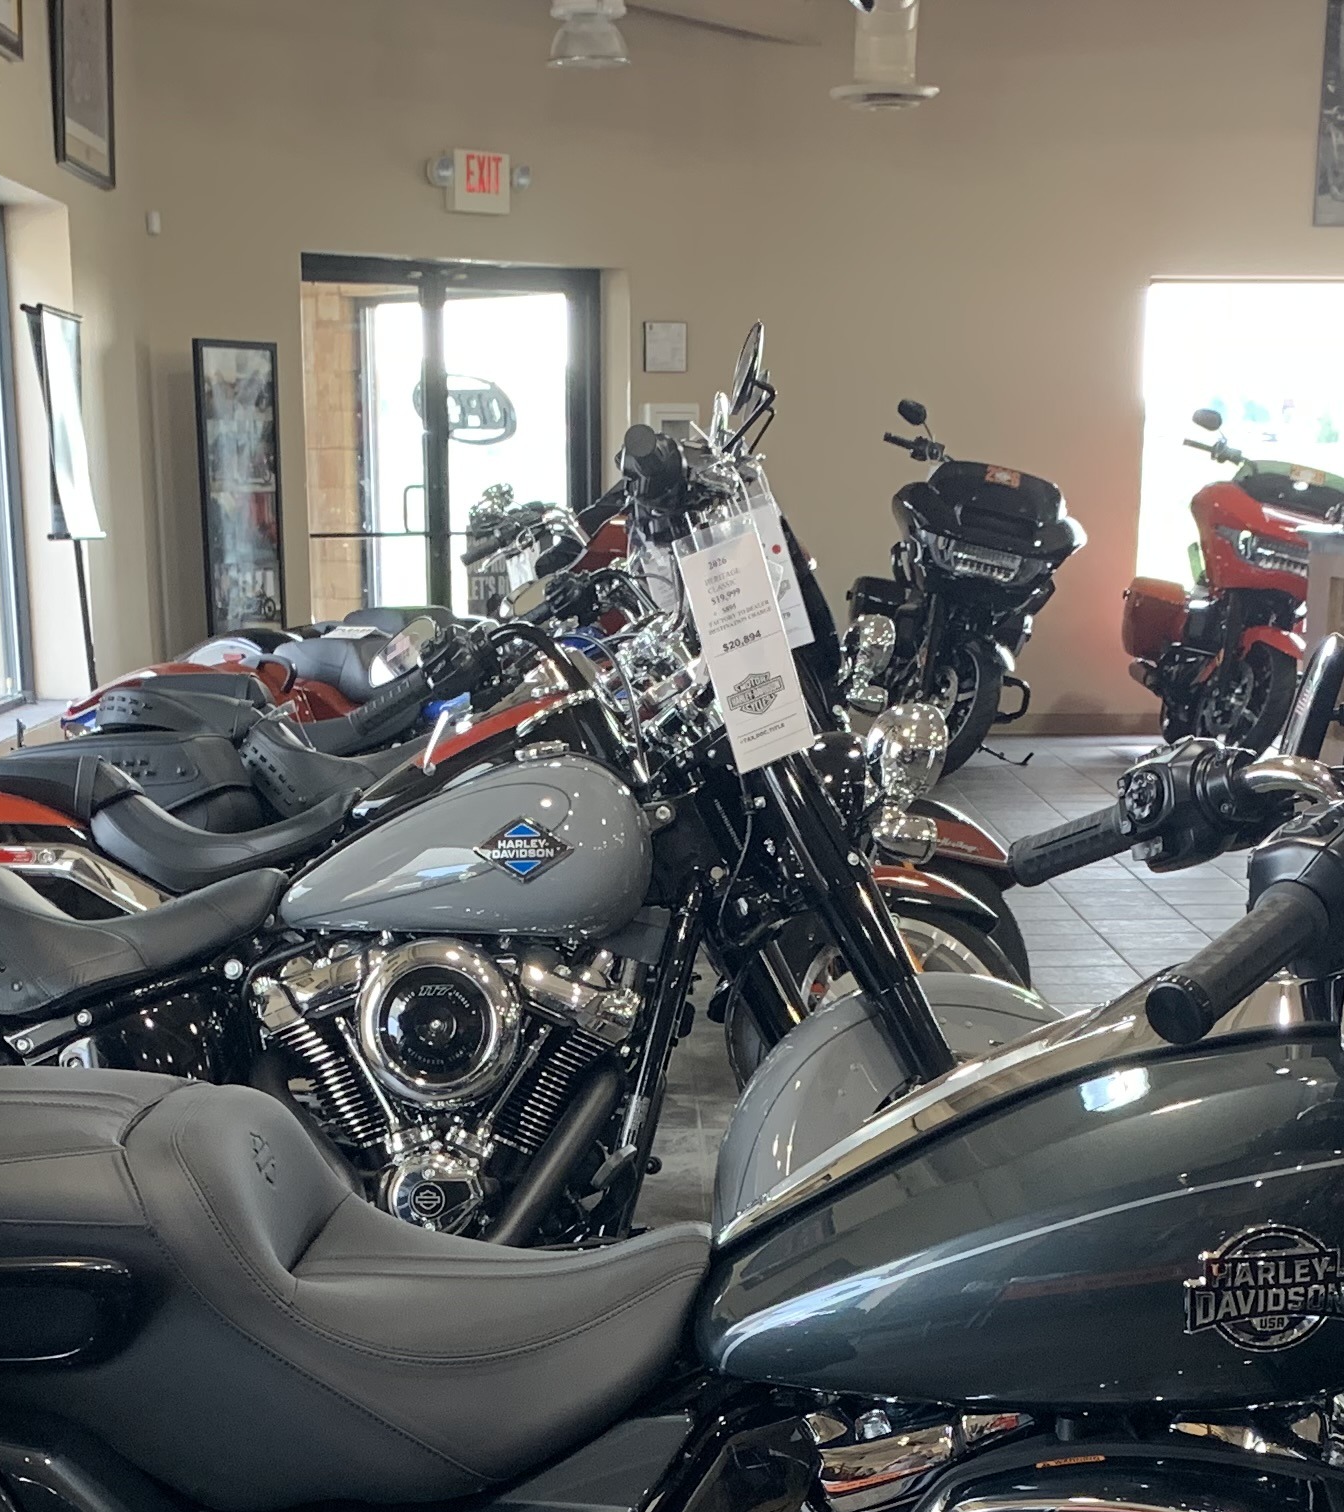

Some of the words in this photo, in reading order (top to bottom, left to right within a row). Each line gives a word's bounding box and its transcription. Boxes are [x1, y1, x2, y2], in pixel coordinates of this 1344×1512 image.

[465, 153, 503, 194] EXIT
[708, 557, 727, 571] 2026
[711, 587, 741, 606] $19,999
[722, 629, 762, 652] $20,894
[491, 848, 555, 860] DAVIDSON
[418, 984, 454, 997] 117
[1259, 1316, 1285, 1330] USA
